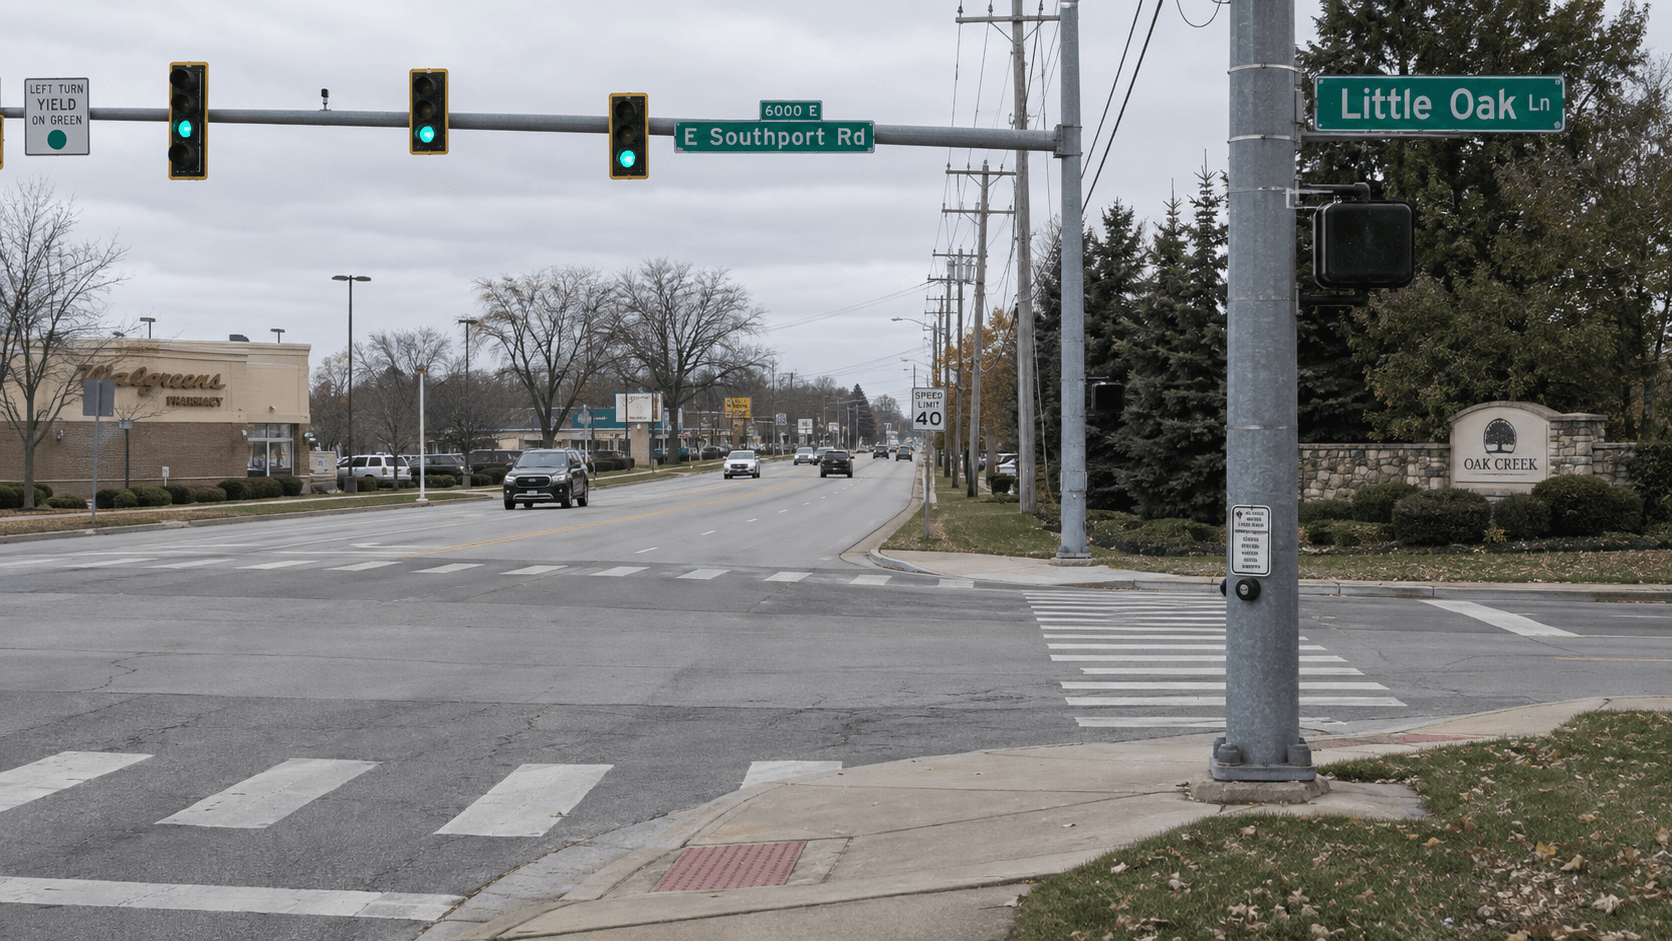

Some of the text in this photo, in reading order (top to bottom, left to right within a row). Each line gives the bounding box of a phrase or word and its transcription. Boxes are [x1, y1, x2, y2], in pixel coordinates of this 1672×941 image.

[30, 84, 83, 94] LEFT TURN
[37, 98, 76, 111] YIELD
[1341, 87, 1550, 120] Little Oak Ln
[765, 105, 818, 117] 6000 E
[32, 115, 82, 125] ON GREEN
[684, 127, 865, 150] E Southport Rd
[166, 396, 223, 407] PHARMACY
[915, 391, 943, 400] SPEED
[915, 411, 942, 426] 40
[1464, 457, 1538, 470] OAK CREEK
